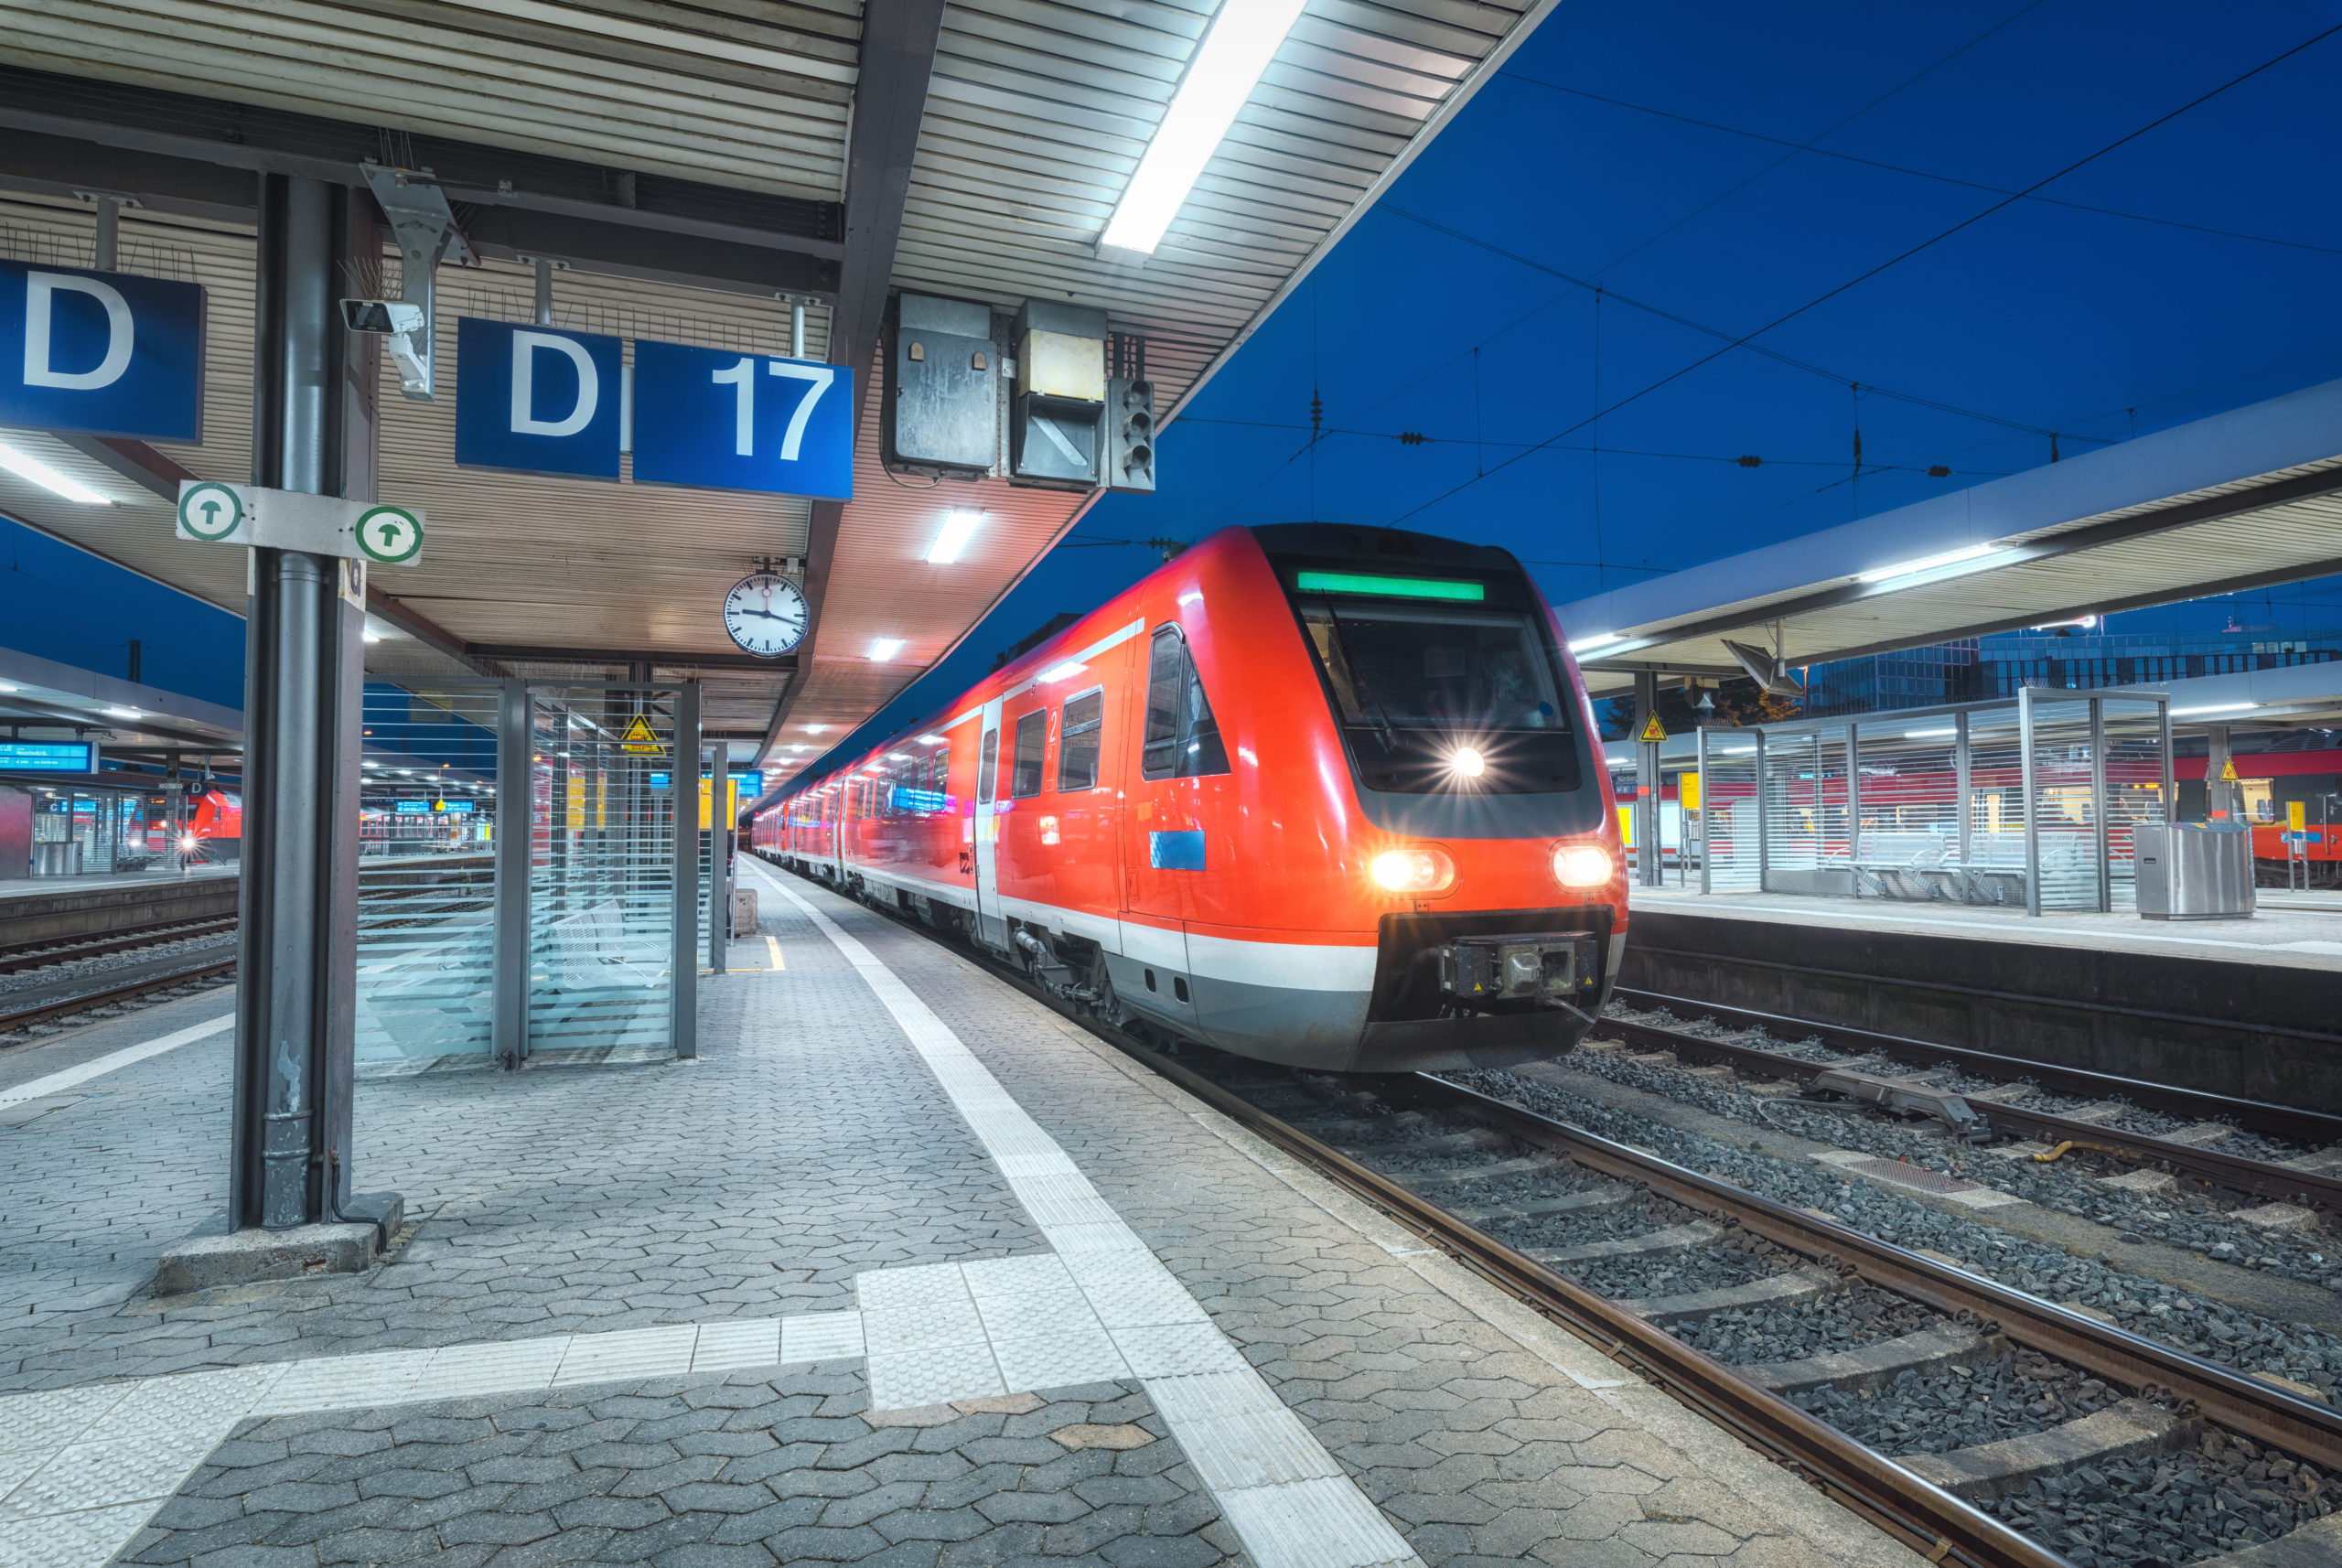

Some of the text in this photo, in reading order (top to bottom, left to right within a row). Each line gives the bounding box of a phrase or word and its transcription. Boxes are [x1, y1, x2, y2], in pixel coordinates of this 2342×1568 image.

[24, 270, 134, 391] D
[510, 329, 599, 437] D
[712, 357, 834, 461] 17
[1049, 711, 1057, 742] 2
[50, 803, 58, 811] C
[191, 782, 202, 794] D
